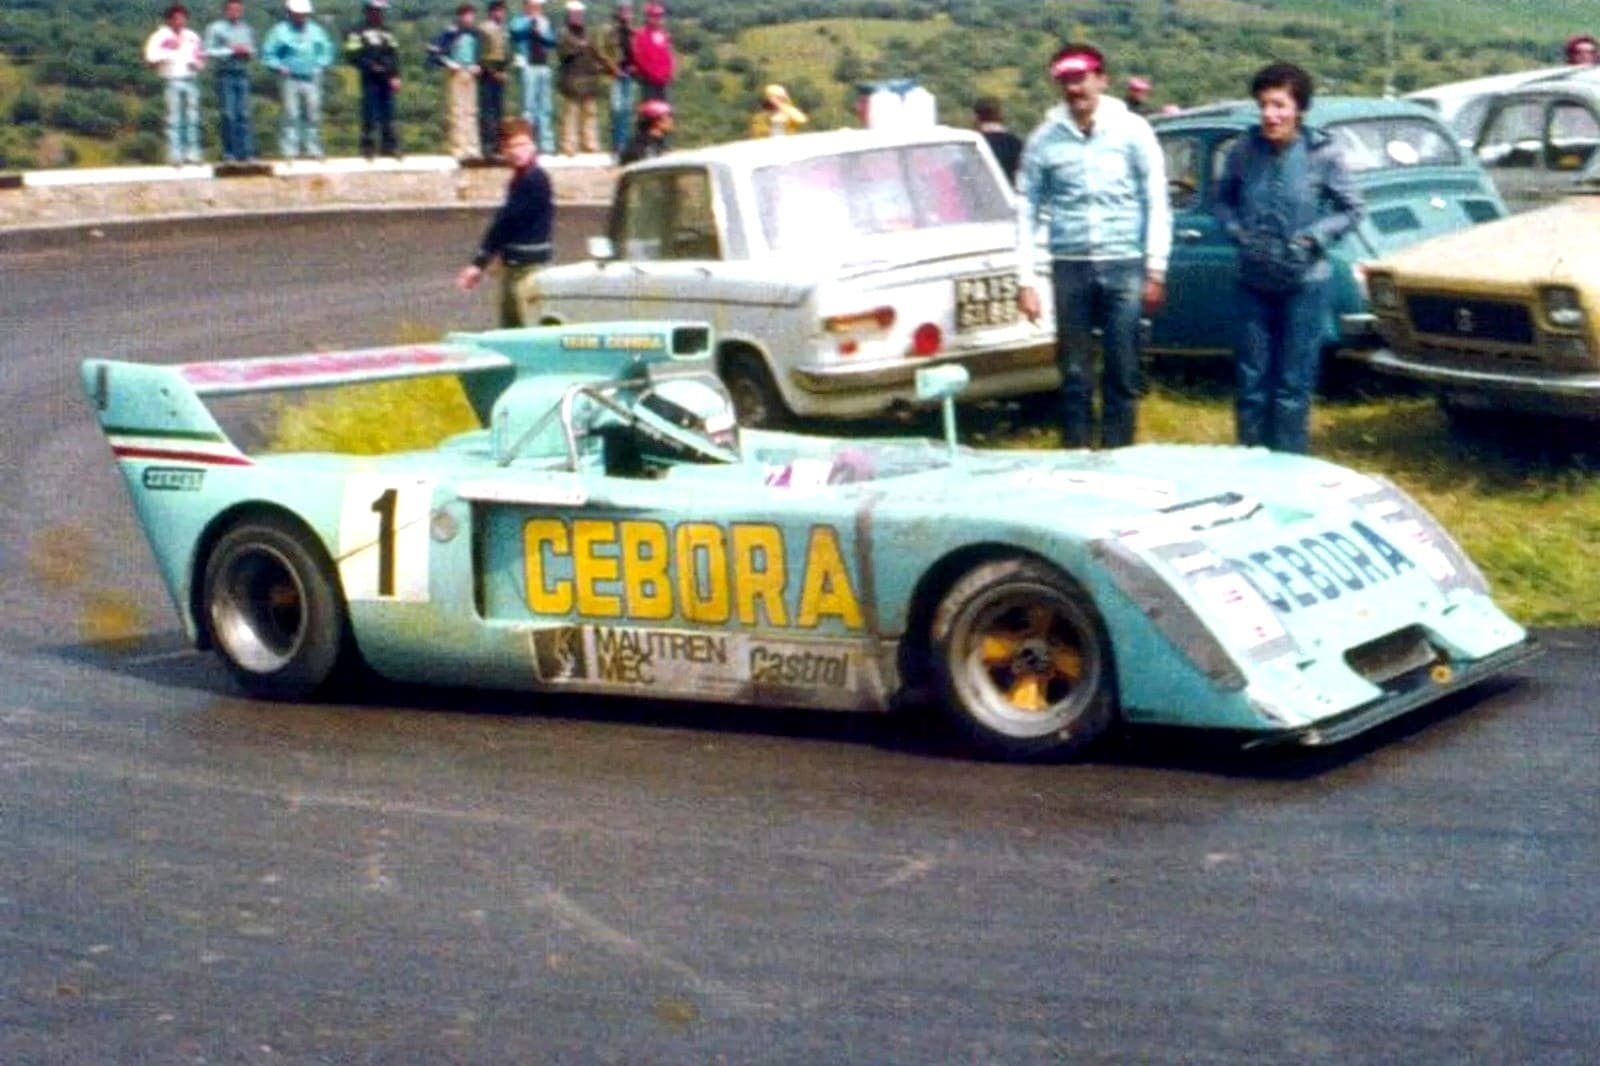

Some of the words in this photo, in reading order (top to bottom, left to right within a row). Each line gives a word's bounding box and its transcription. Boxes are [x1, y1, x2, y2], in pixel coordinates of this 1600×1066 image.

[371, 488, 398, 596] 1
[522, 516, 866, 630] CEBORA
[1219, 519, 1416, 614] CEBORA
[595, 627, 727, 664] MAUTREN
[598, 652, 655, 684] MEC
[750, 645, 849, 689] Castrol
